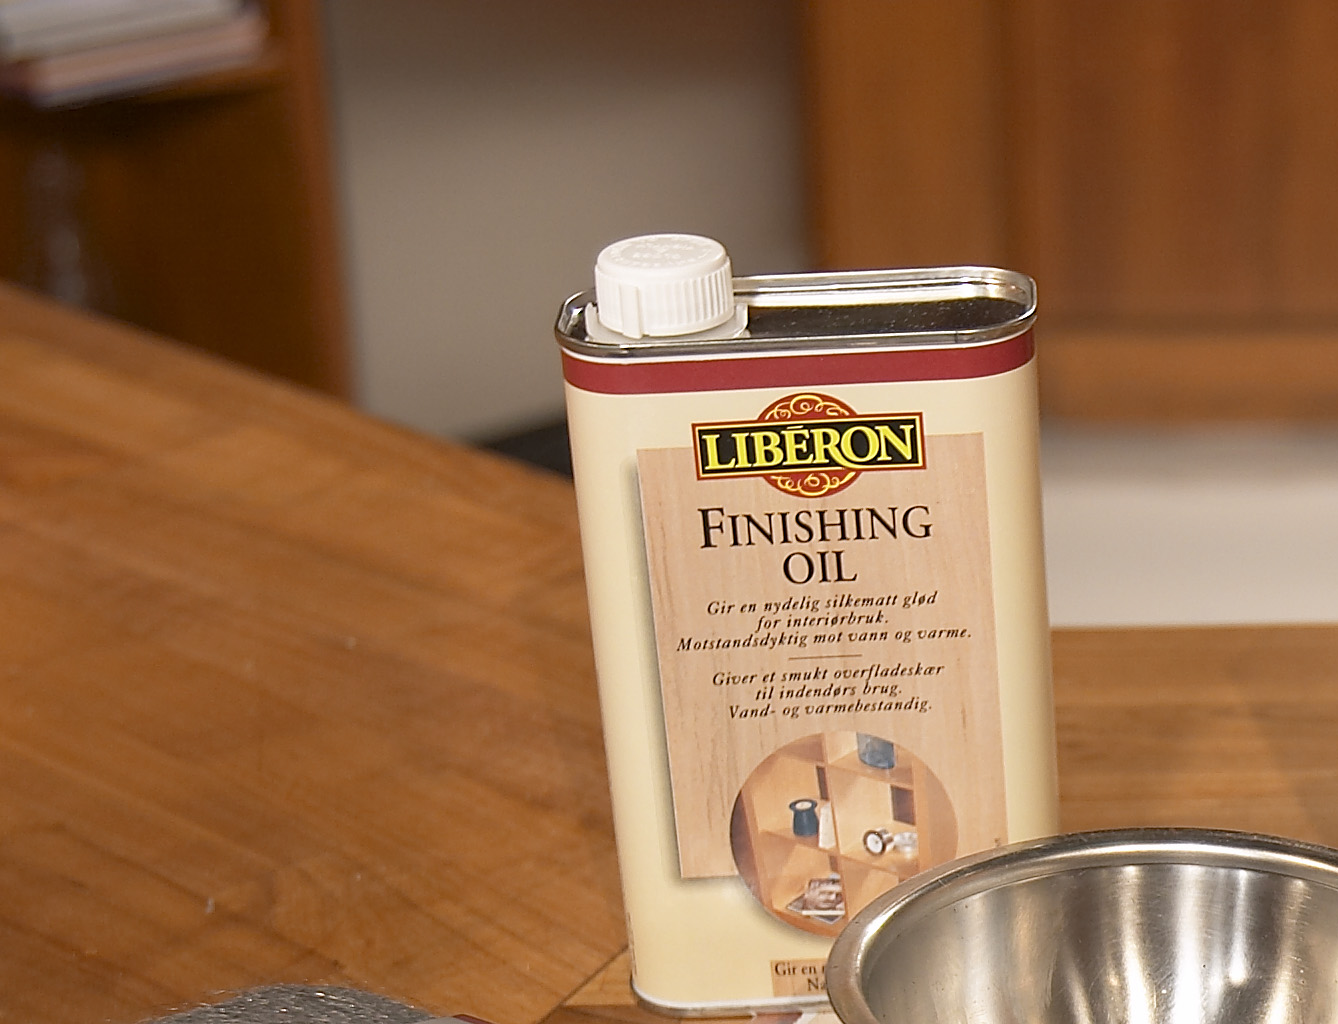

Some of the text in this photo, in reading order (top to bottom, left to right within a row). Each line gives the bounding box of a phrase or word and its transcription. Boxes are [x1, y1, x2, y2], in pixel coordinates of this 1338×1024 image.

[697, 505, 933, 549] FINISHING
[783, 550, 858, 584] OIL
[707, 590, 938, 616] Gir en nydelig silkematt glød
[755, 610, 889, 633] for interiørbruk.
[676, 627, 972, 652] Motstandsdyktig mot vann og varme.
[712, 663, 945, 686] Giver et smukt overfladeskær
[755, 679, 902, 701] til indendørs brug.
[729, 697, 933, 719] Vand- og varmebestandig.
[774, 961, 817, 976] Gir en
